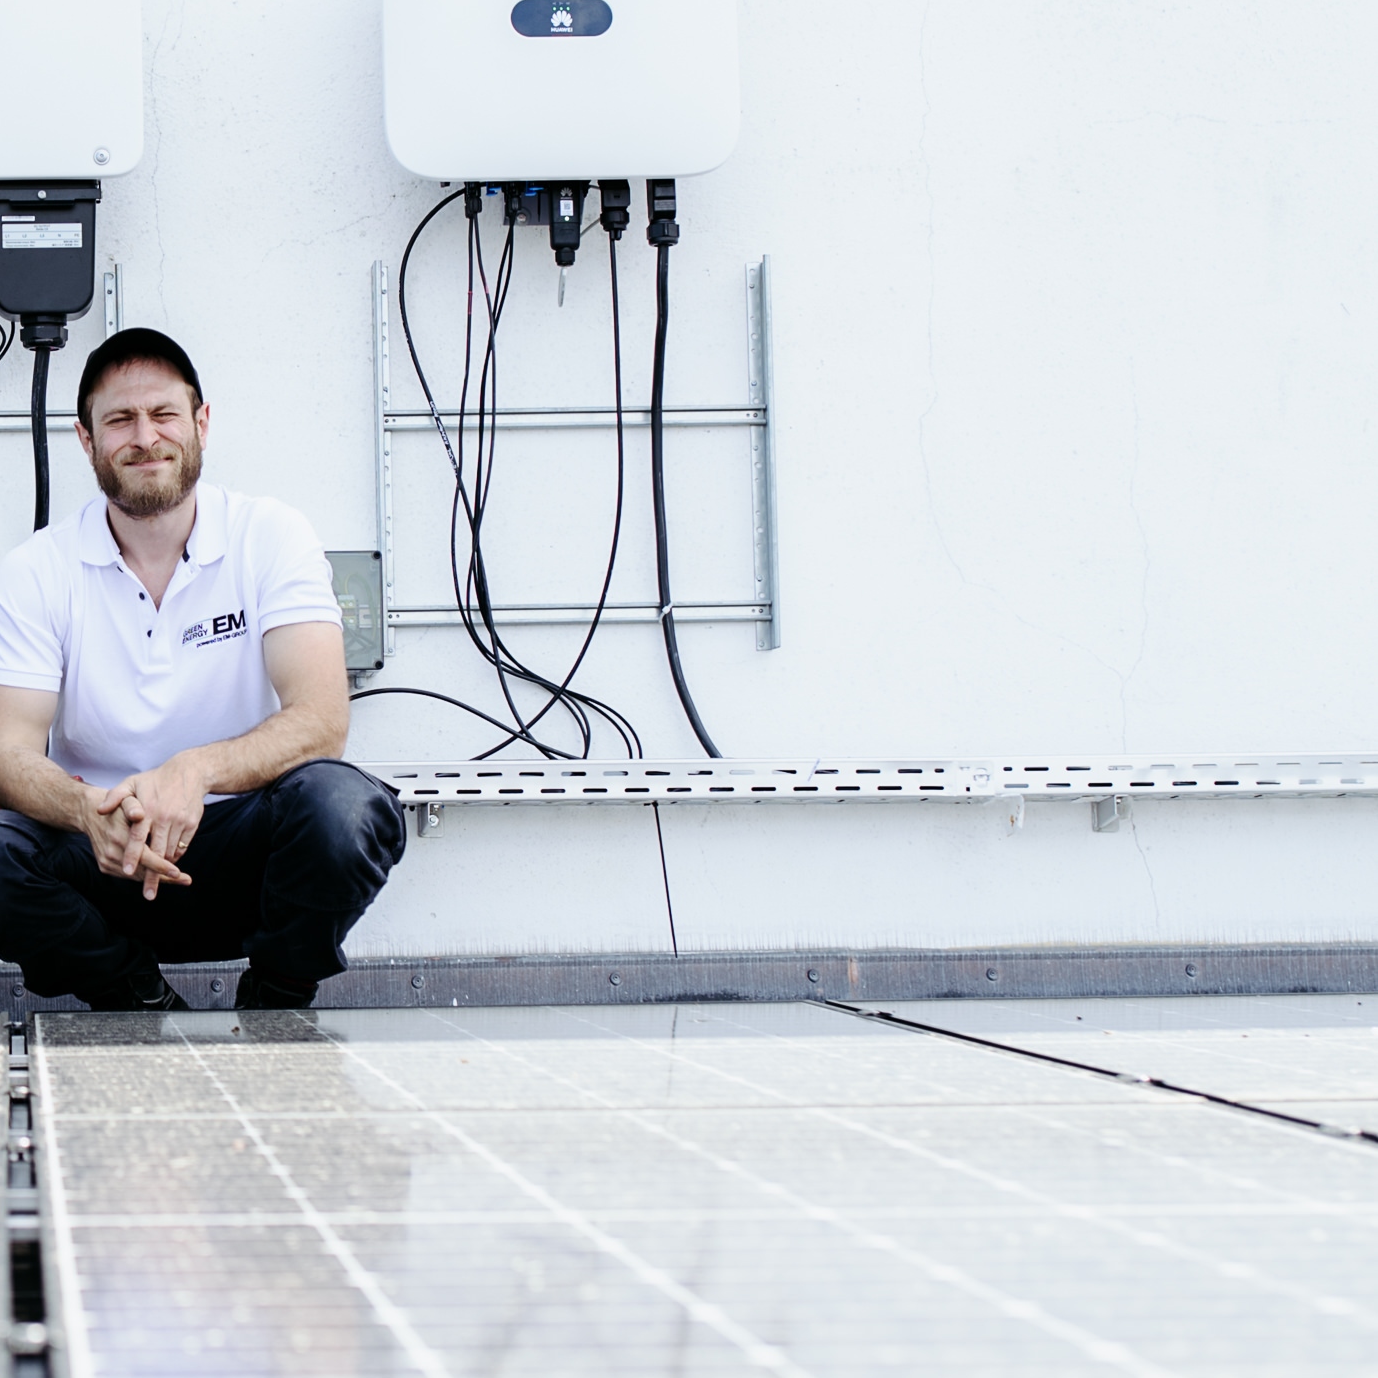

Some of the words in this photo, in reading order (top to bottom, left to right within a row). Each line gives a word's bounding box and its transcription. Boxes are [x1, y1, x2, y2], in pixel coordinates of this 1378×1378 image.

[182, 623, 203, 637] GREEN
[212, 609, 247, 635] EM
[182, 628, 208, 644] ENERGY
